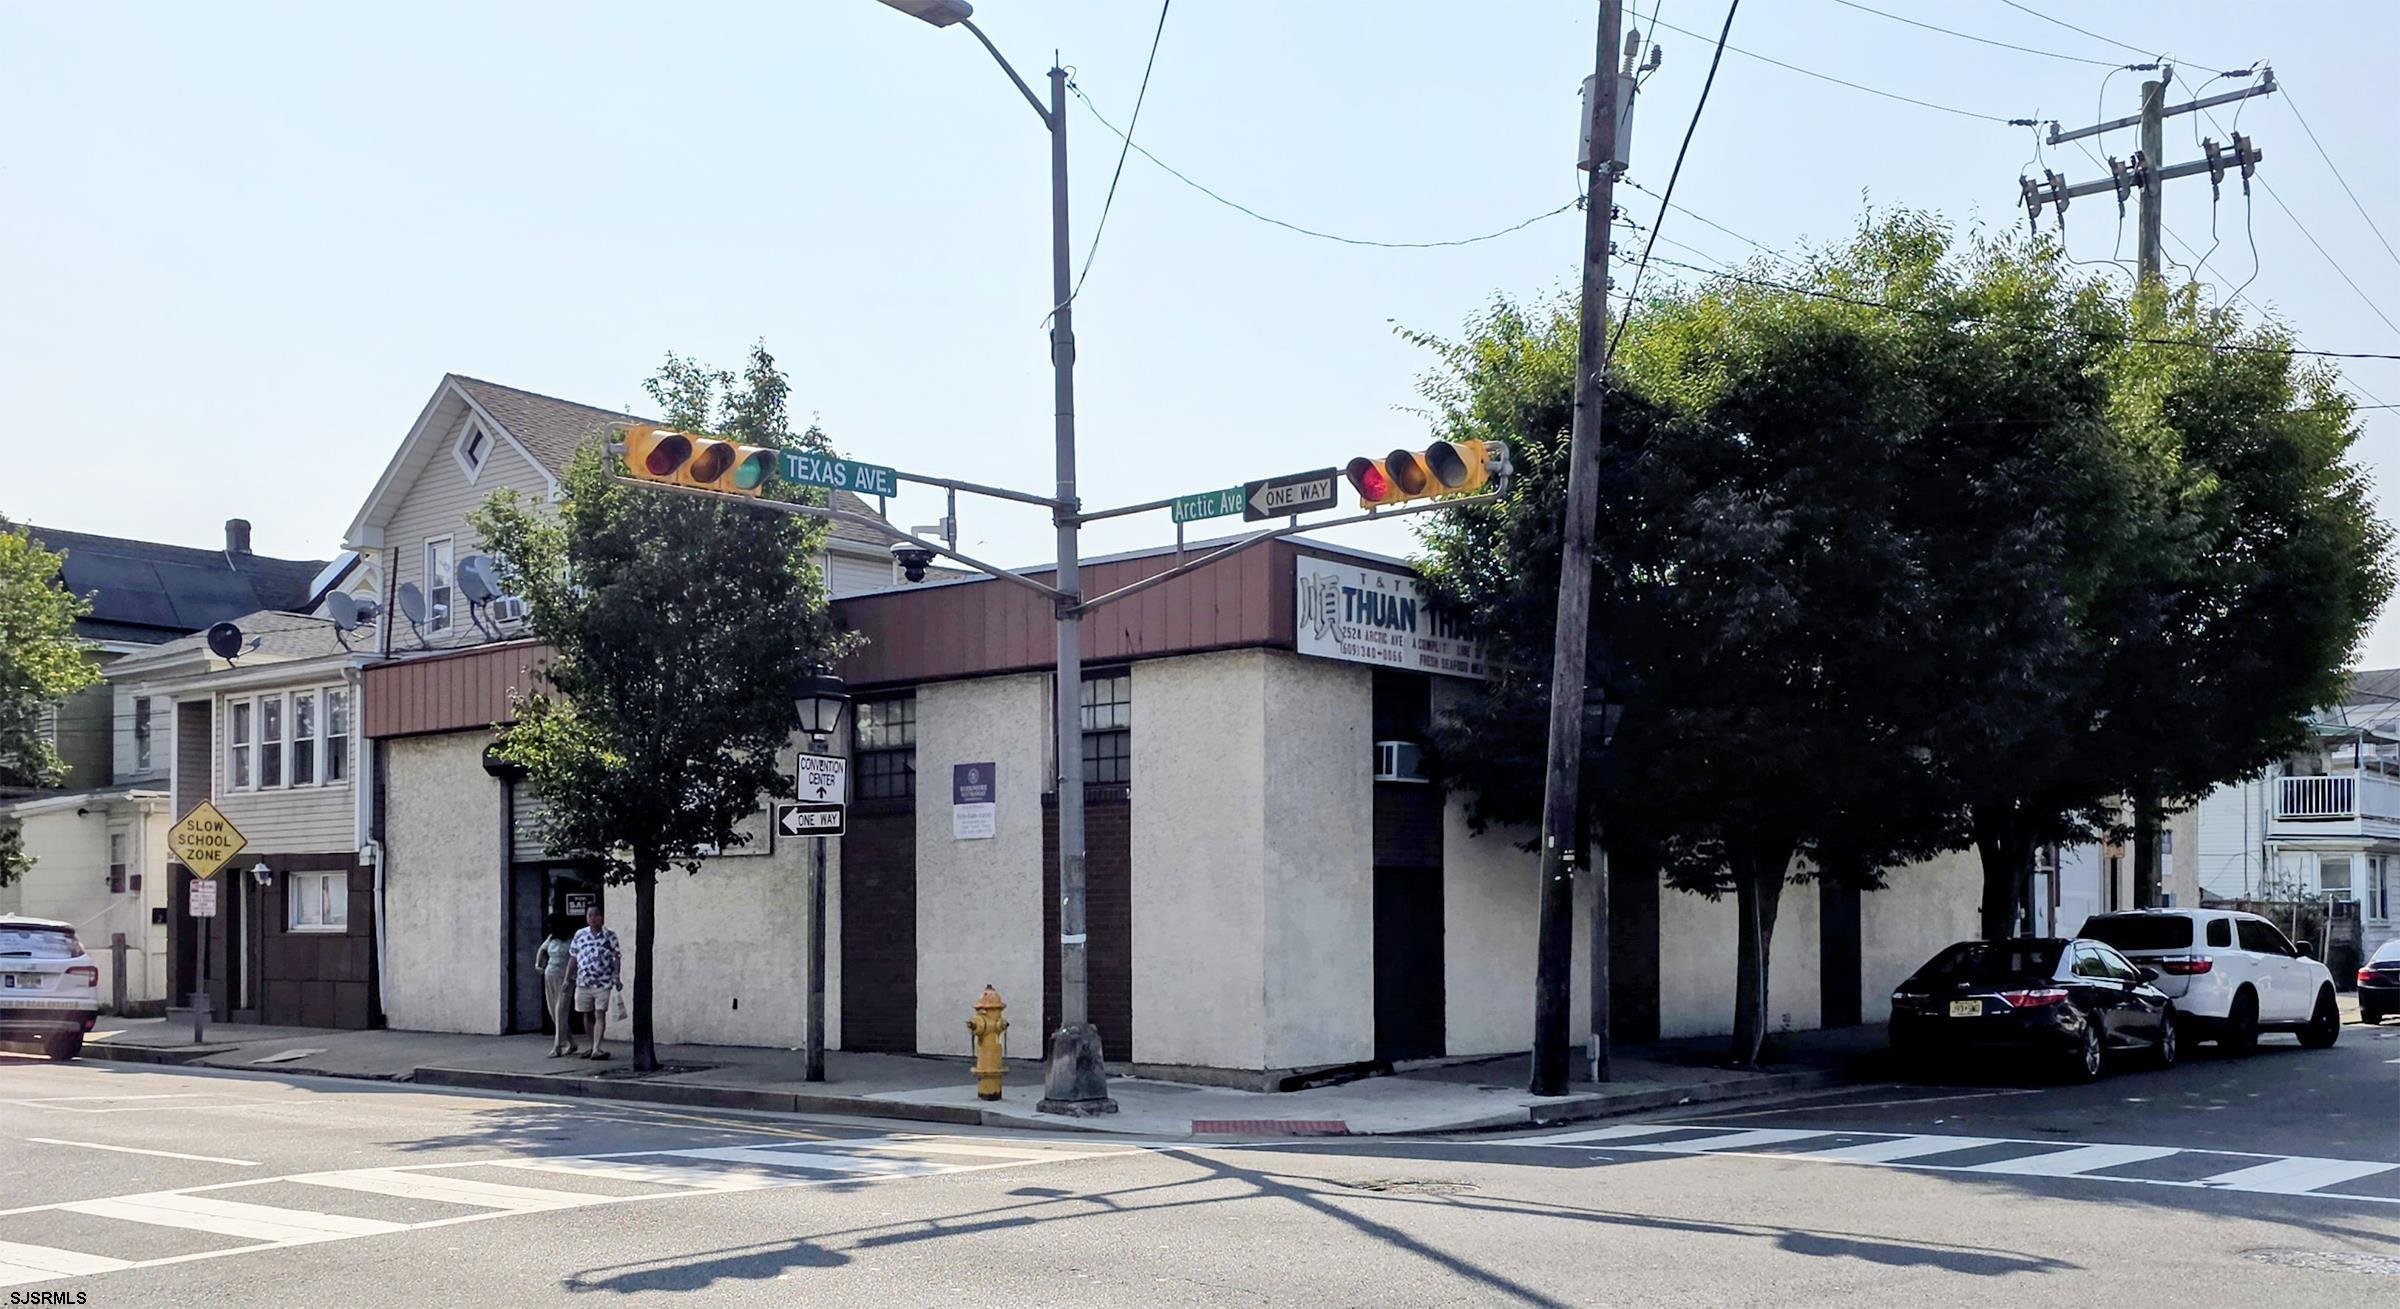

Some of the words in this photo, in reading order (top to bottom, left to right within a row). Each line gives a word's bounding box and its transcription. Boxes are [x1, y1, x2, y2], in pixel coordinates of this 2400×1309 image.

[786, 455, 846, 486] TEXAS
[855, 466, 892, 494] AVE.
[1266, 488, 1293, 506] ONE
[1300, 482, 1329, 500] WAY
[1175, 497, 1215, 521] Arctic
[1220, 492, 1242, 514] Ave
[1360, 573, 1366, 585] T
[1376, 576, 1384, 588] &
[1342, 586, 1416, 634] THUAN
[1342, 626, 1361, 640] 2524
[1365, 630, 1387, 644] ARCTIC
[1391, 635, 1403, 647] AVE
[1420, 654, 1439, 668] FRESH
[800, 757, 844, 774] CONVENTION
[808, 772, 835, 787] CENTER
[187, 820, 224, 832] SLOW
[798, 814, 815, 827] ONE
[820, 814, 838, 825] WAY
[178, 834, 231, 847] SCHOOL
[186, 849, 222, 861] ZONE
